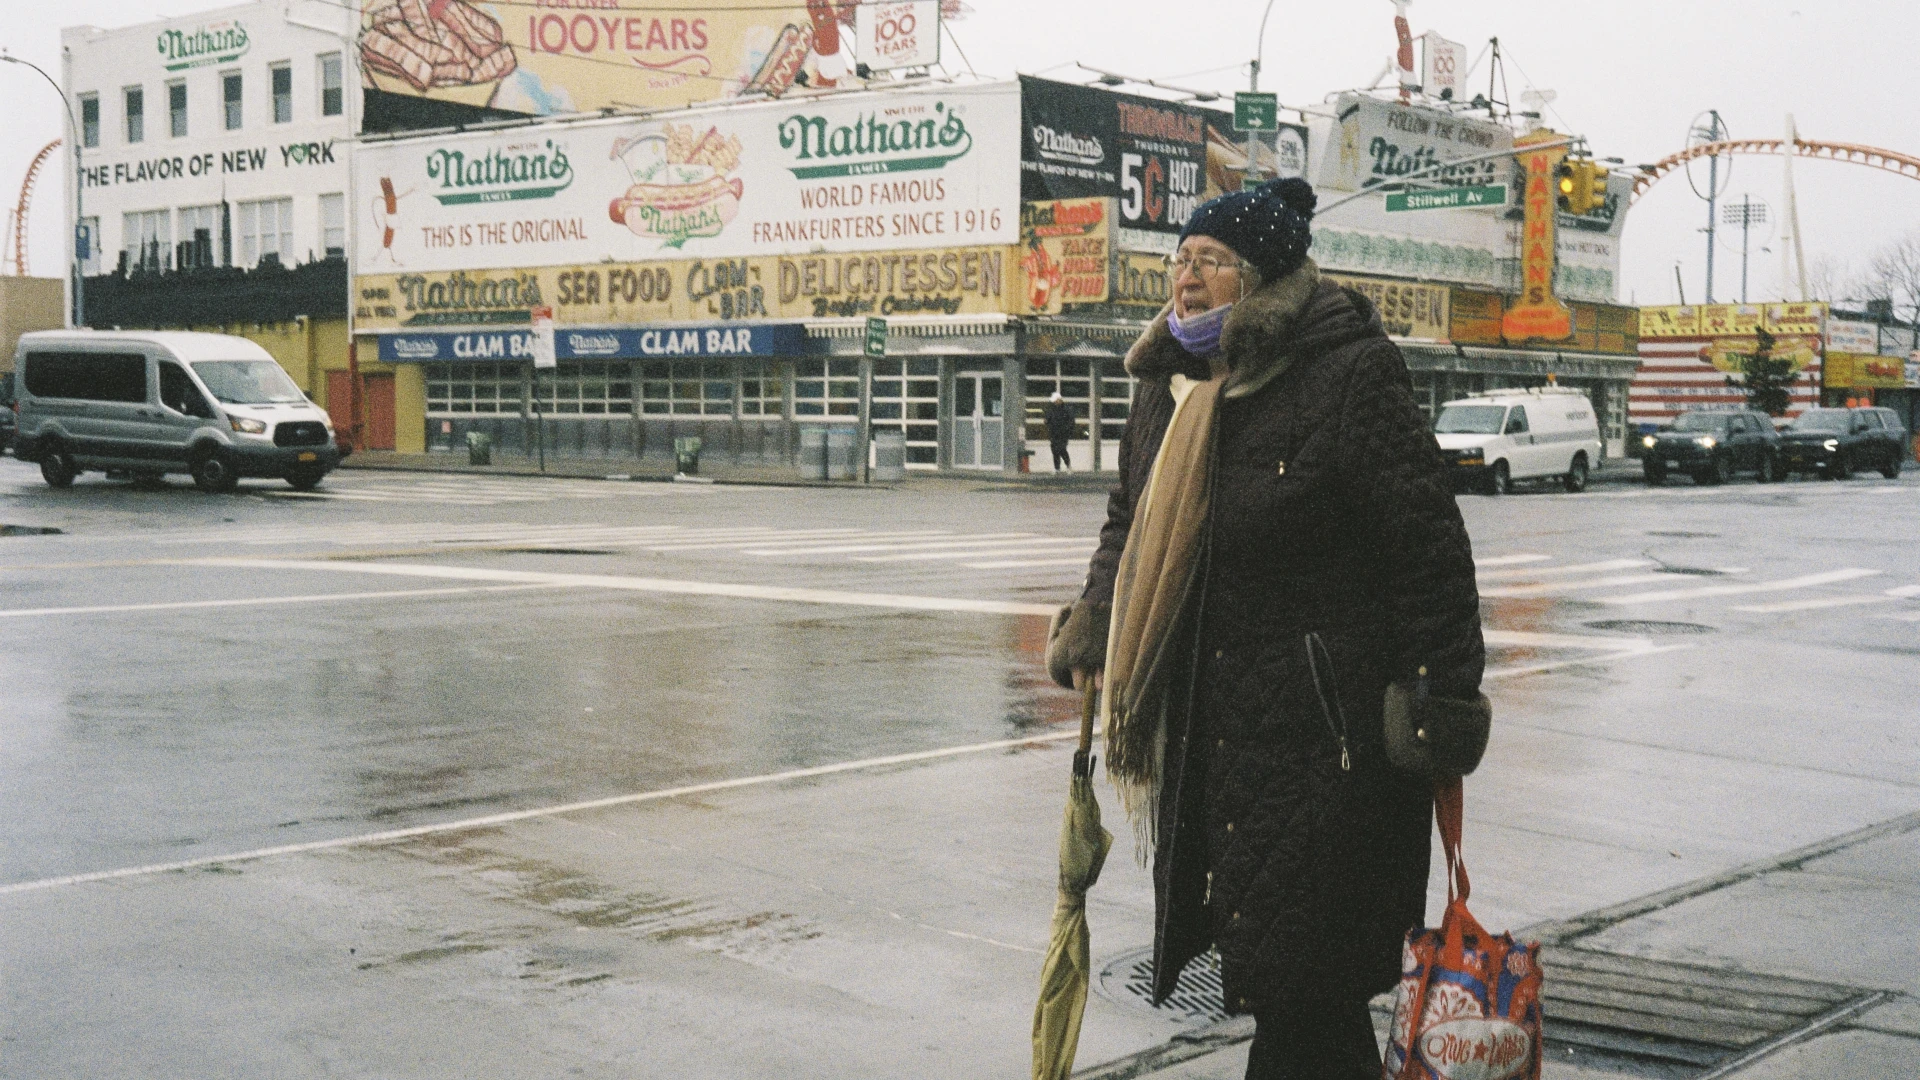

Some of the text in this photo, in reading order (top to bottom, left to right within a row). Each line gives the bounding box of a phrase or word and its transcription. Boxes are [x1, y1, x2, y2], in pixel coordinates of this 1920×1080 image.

[875, 14, 916, 43] 100
[778, 101, 966, 160] Nathan's
[115, 156, 184, 183] FLAVOR
[189, 153, 214, 176] OF
[222, 148, 267, 173] NEW
[426, 139, 568, 187] Nathan's
[1169, 159, 1199, 194] HOT
[800, 178, 945, 209] WORLD FAMOUS
[1407, 191, 1484, 208] Stillwell Av
[421, 217, 588, 248] THIS IS THE ORIGINAL
[753, 208, 1001, 243] FRANKFURTERS SINCE 1916
[397, 270, 543, 311] Nathan's
[557, 267, 672, 306] SEA FOOD
[687, 258, 748, 301] CLAM
[778, 250, 1001, 304] DELICATESSEN
[720, 285, 768, 320] BAR
[453, 334, 536, 358] CLAM BA
[640, 328, 752, 354] CLAM BAR
